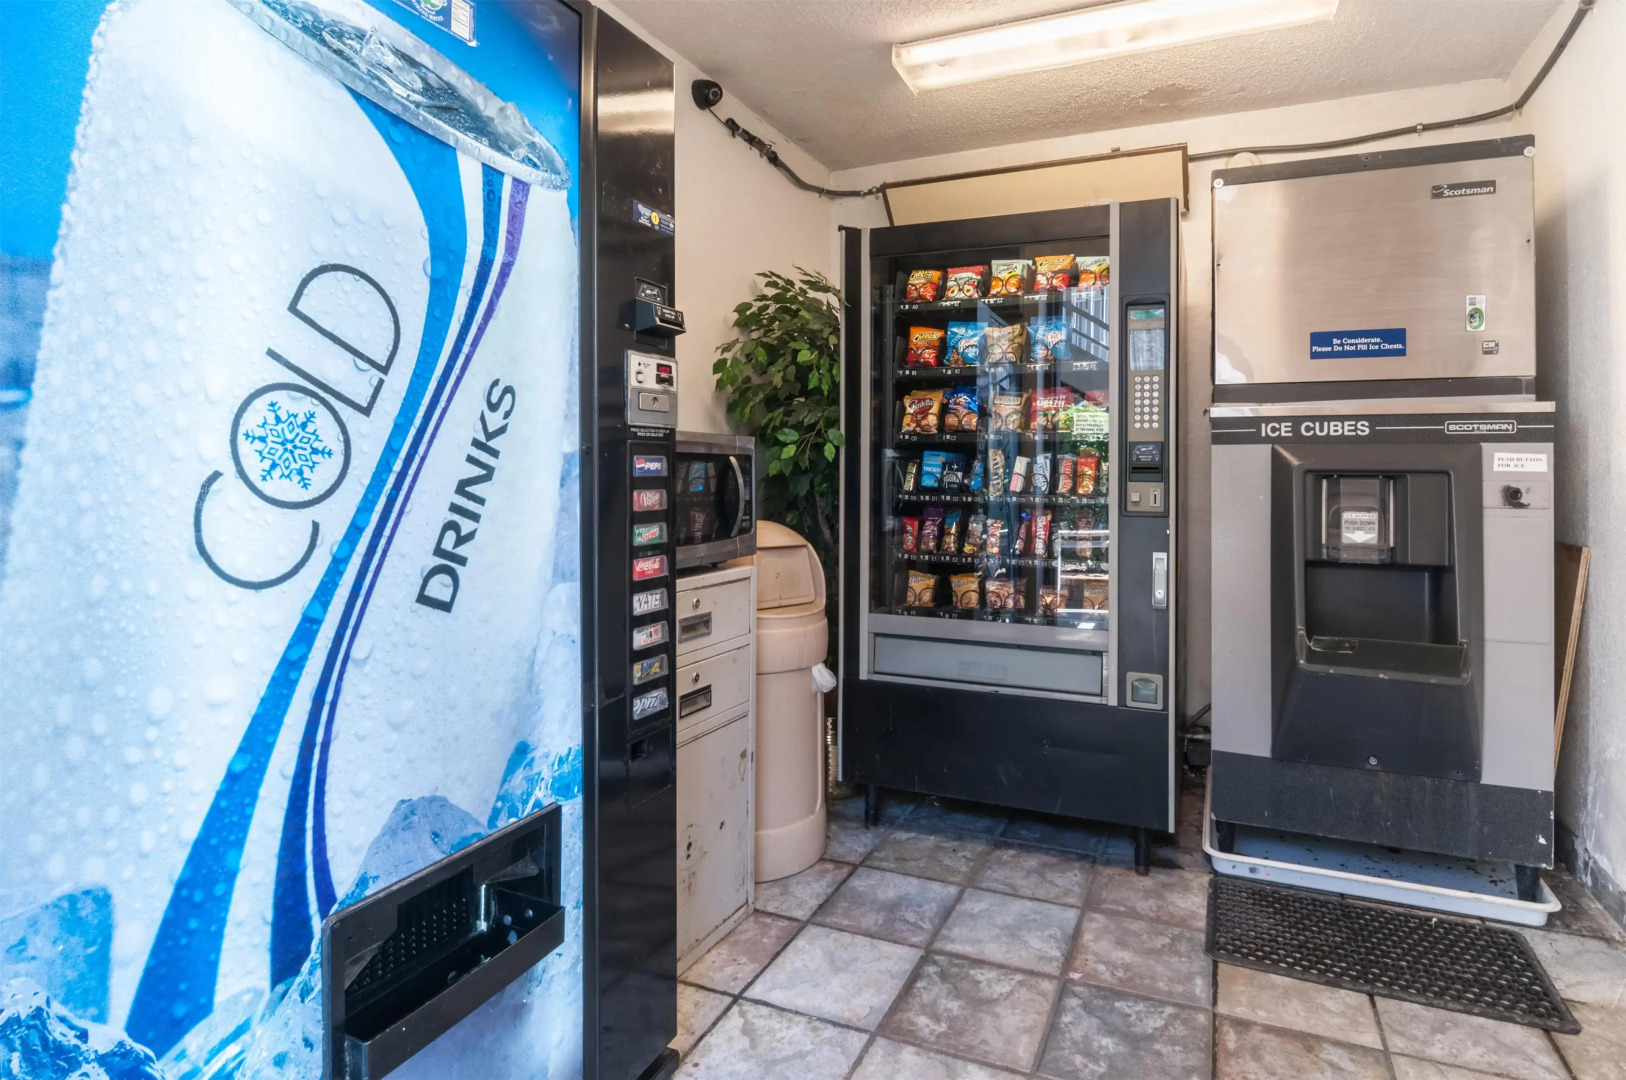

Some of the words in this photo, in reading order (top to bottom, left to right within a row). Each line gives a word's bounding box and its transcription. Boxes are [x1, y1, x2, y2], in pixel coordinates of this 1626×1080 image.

[1442, 186, 1494, 197] Scotsman
[194, 262, 401, 590] COLD
[1261, 422, 1293, 437] ICE
[1300, 420, 1370, 436] CUBES
[1448, 423, 1513, 431] SCOTSMAN
[645, 462, 662, 470] PEPS
[414, 378, 517, 614] DRINKS
[1034, 515, 1046, 555] Skittles
